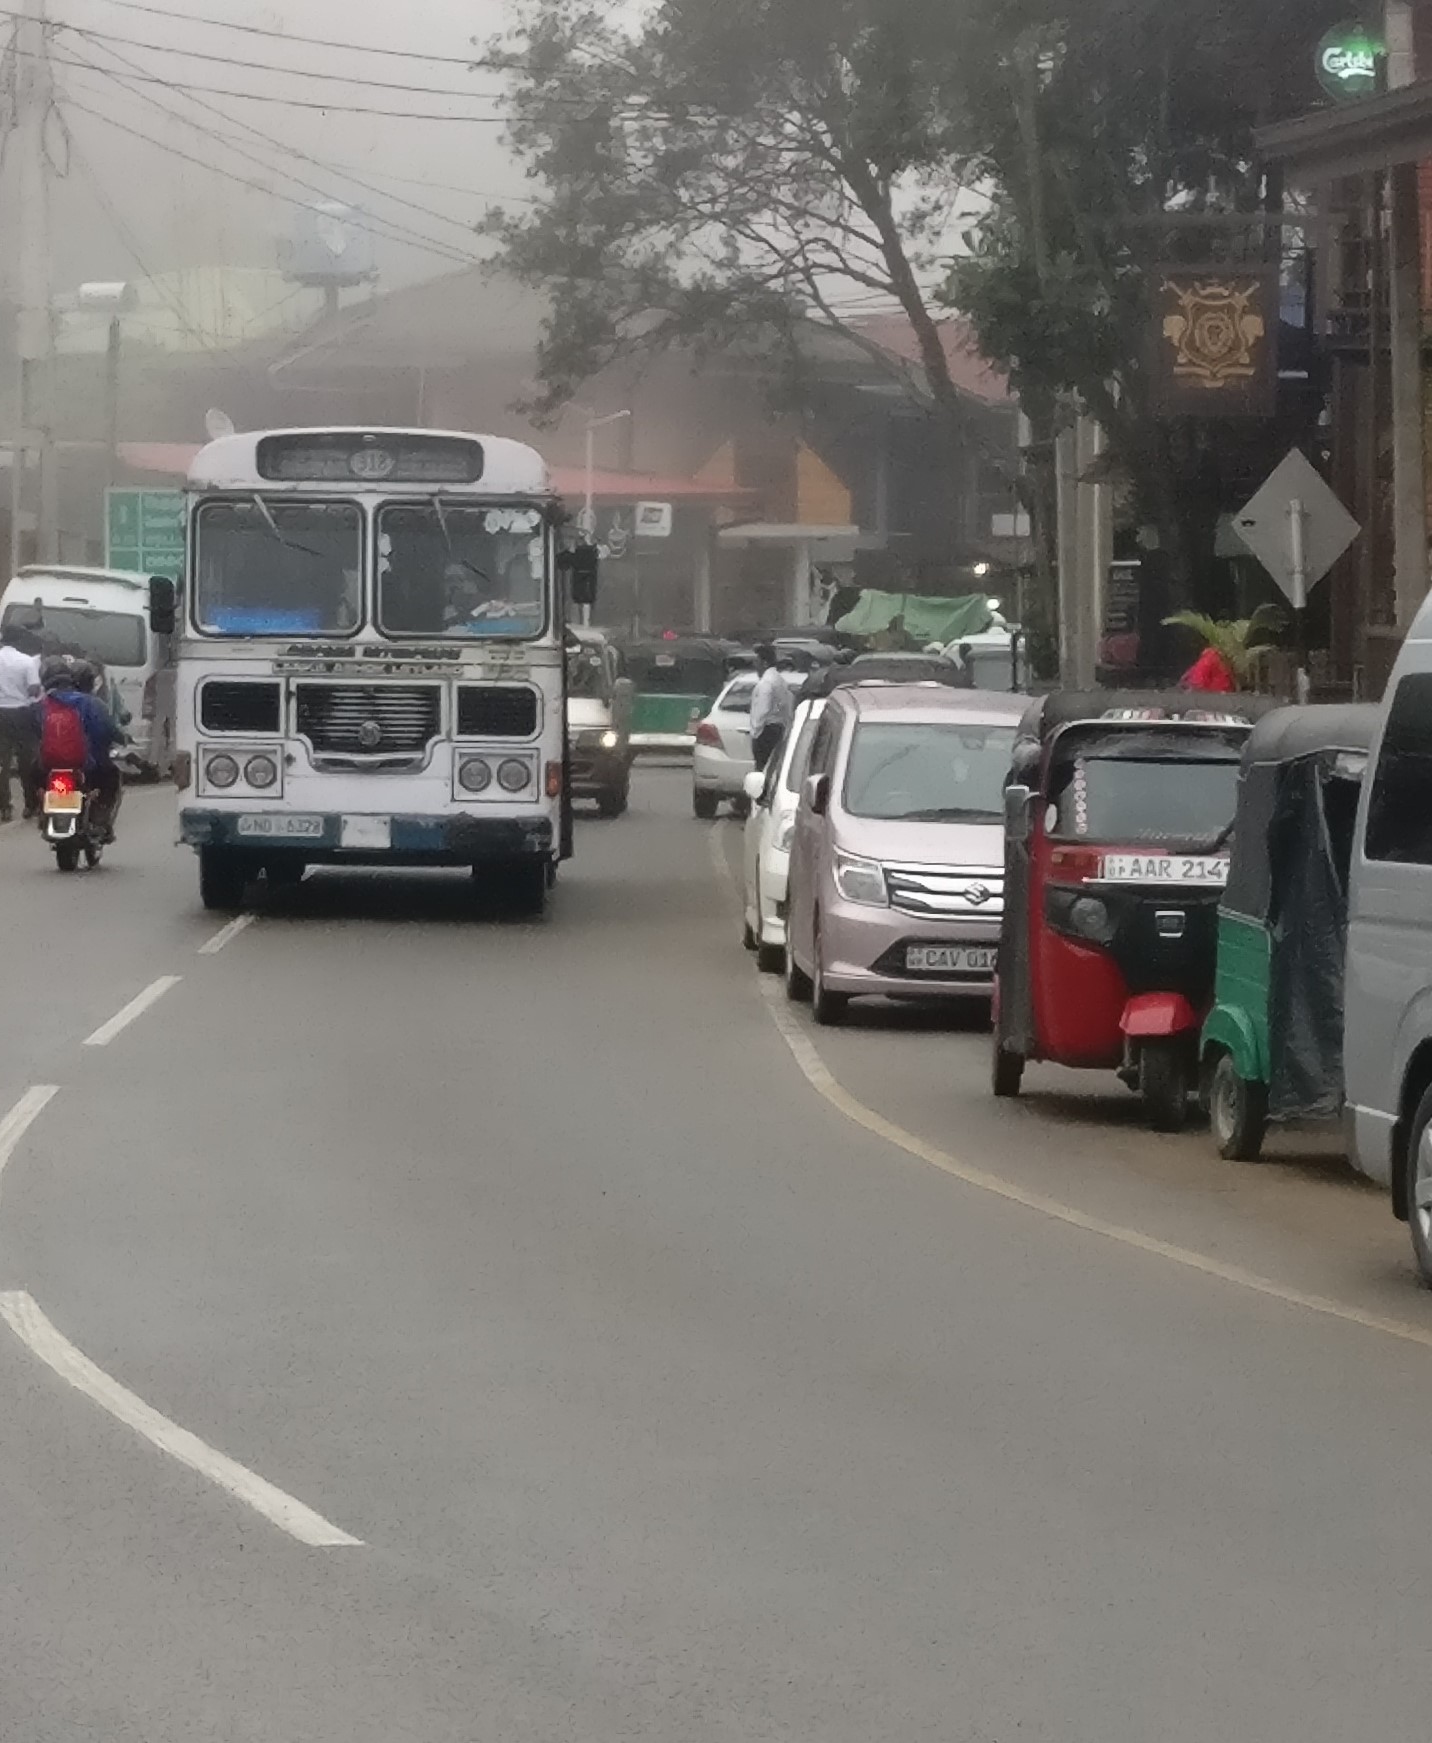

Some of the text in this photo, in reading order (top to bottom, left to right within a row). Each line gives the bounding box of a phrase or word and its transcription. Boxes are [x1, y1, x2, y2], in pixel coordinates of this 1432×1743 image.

[1130, 859, 1172, 878] AAR
[1182, 861, 1230, 879] 214
[926, 949, 961, 967] CAV
